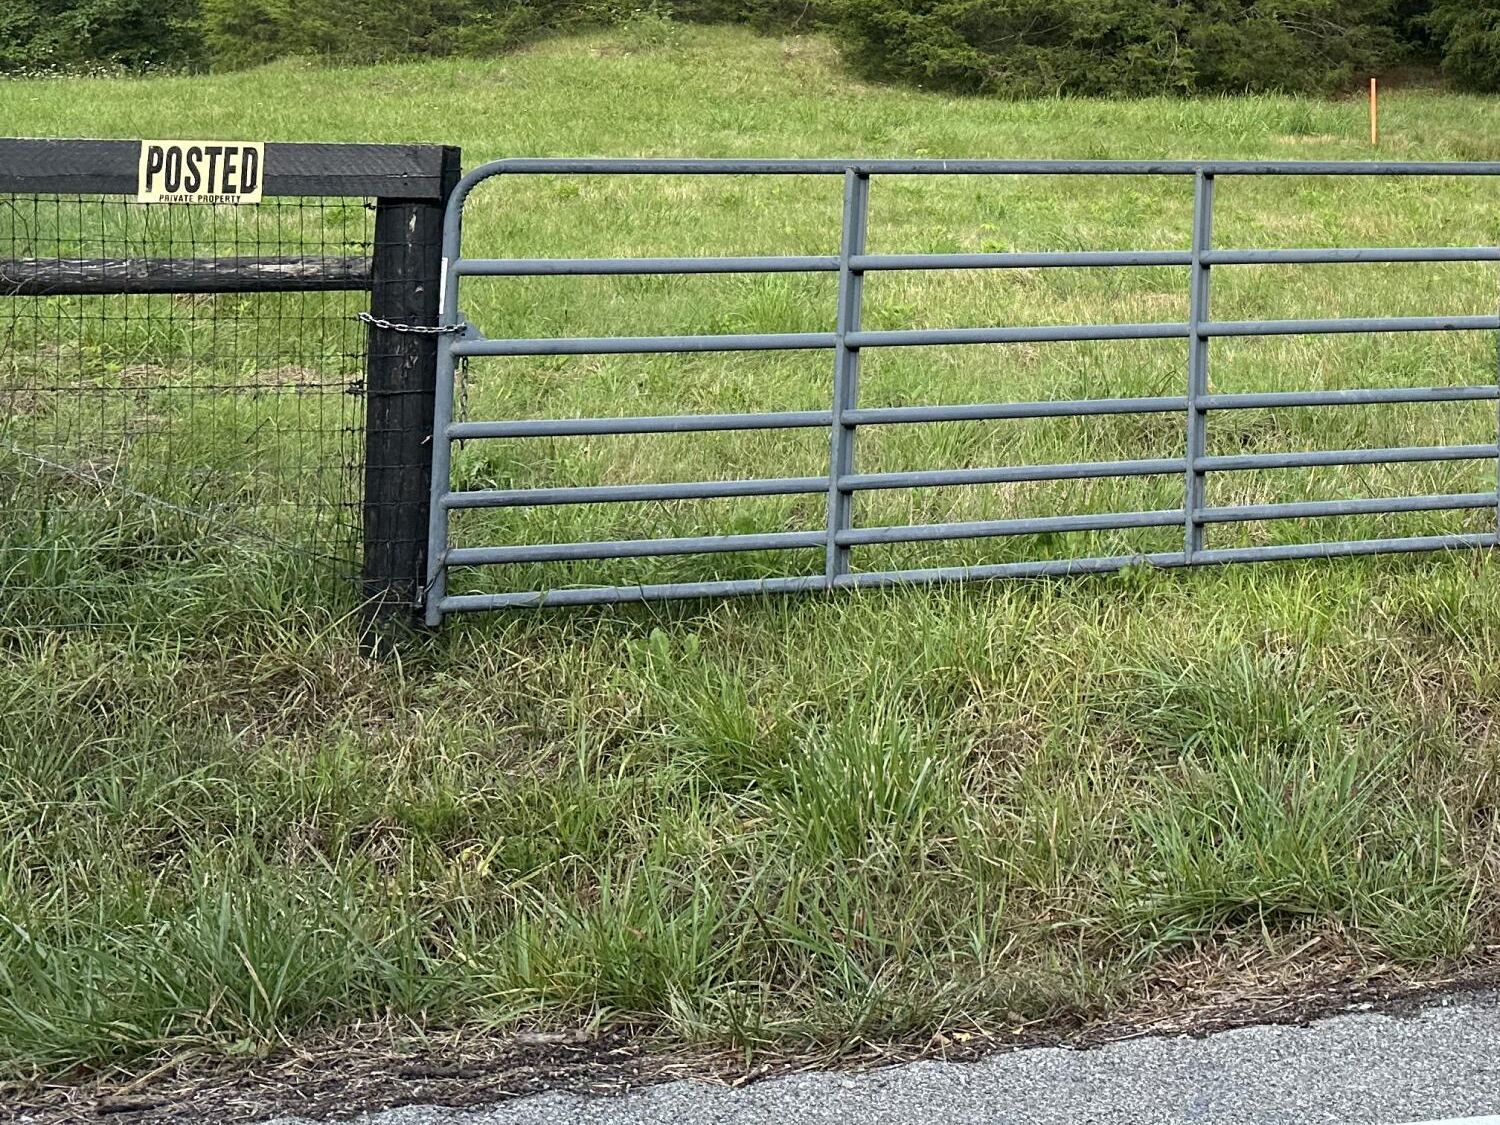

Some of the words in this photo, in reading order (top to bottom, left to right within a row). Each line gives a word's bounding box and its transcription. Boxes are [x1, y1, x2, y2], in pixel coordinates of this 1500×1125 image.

[145, 145, 259, 194] POSTED
[158, 194, 194, 203] PRIVATE
[197, 195, 241, 203] PROPERTY
